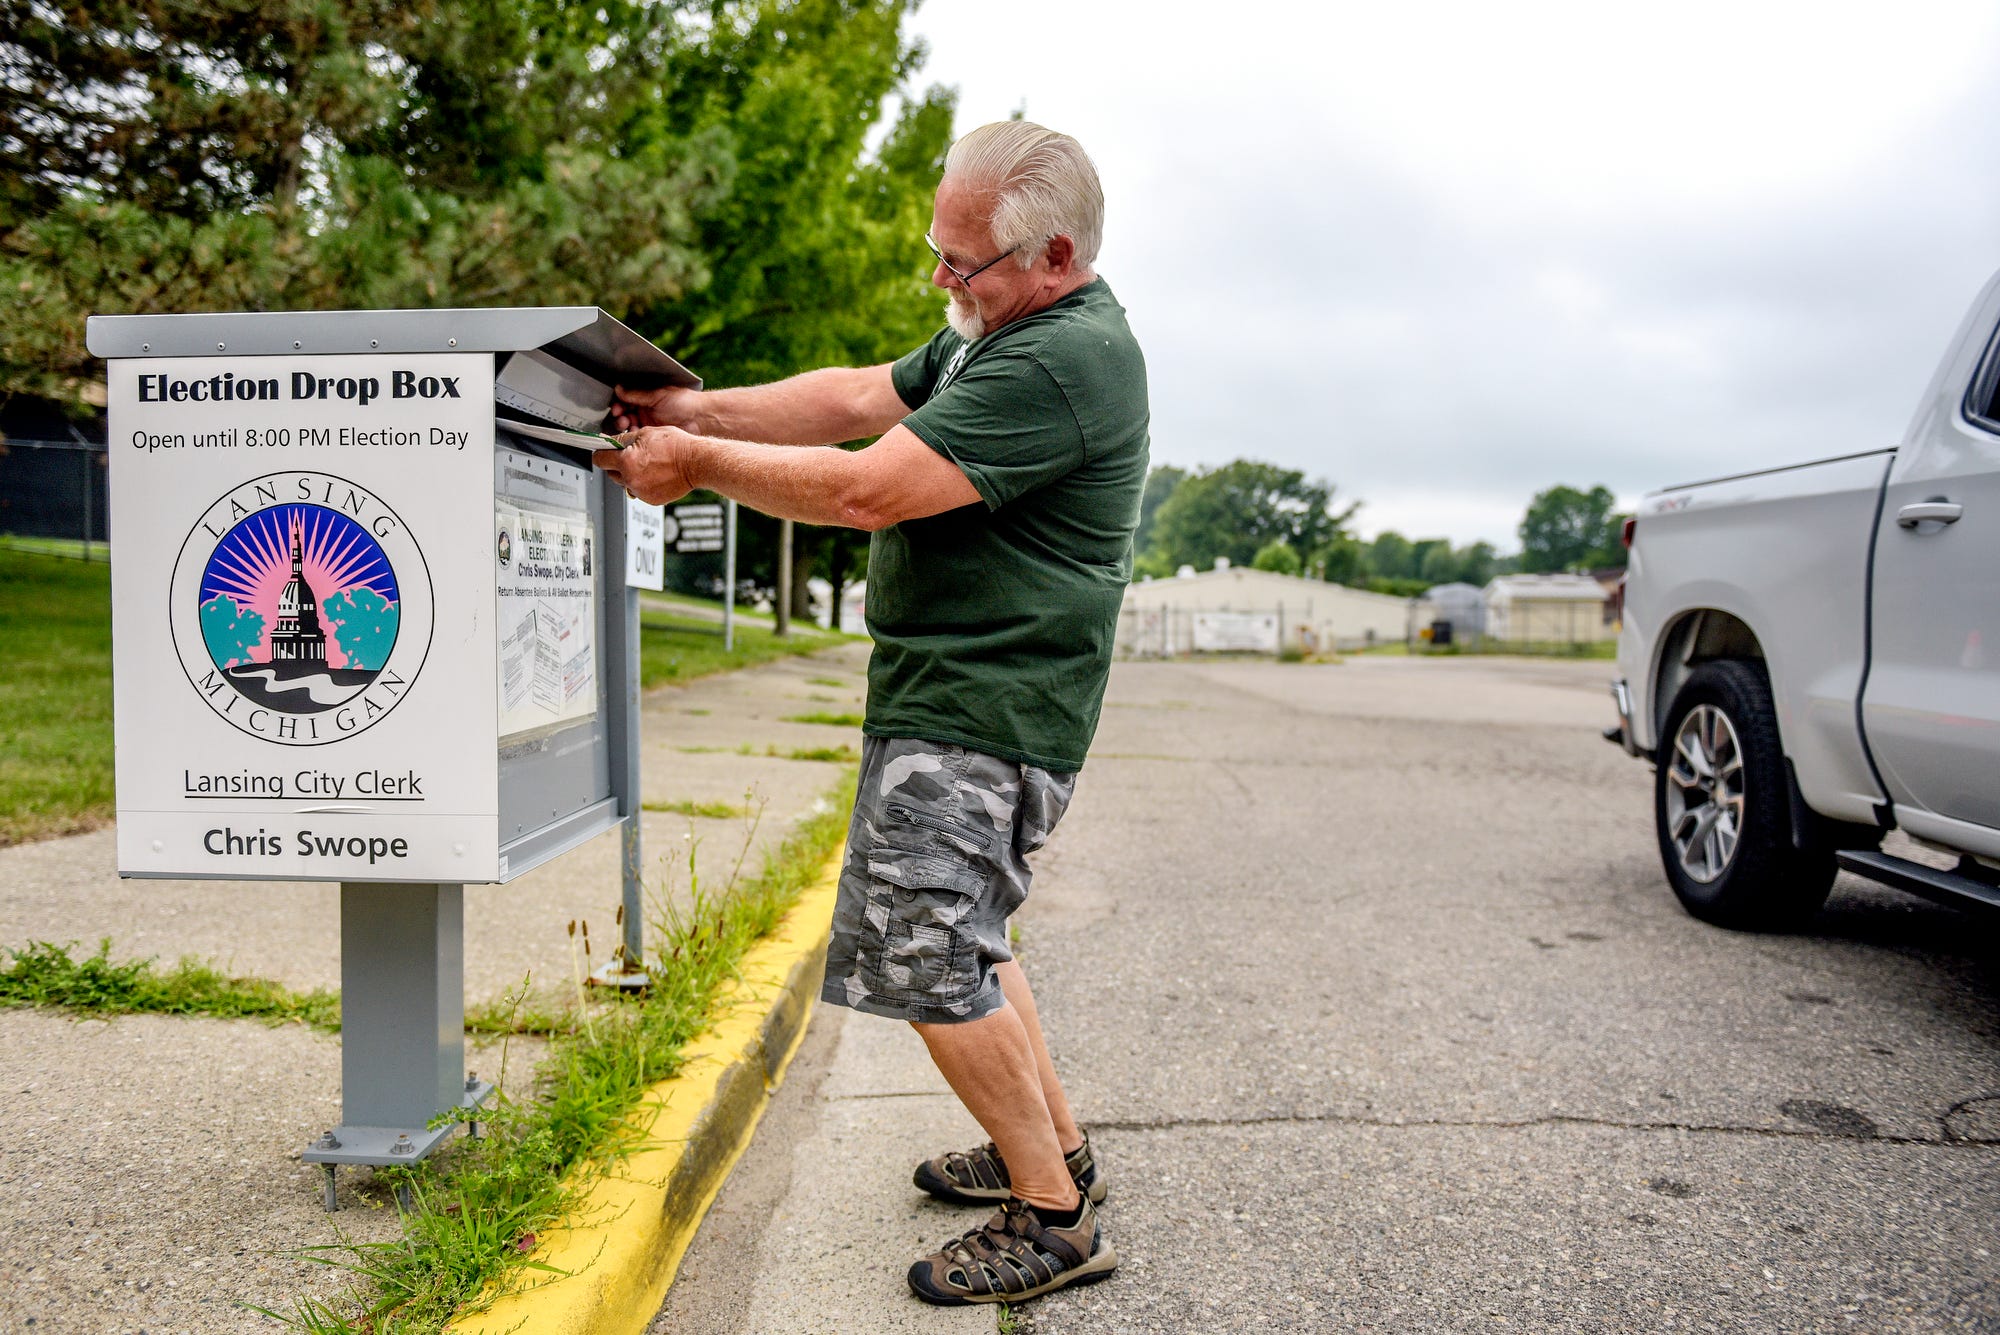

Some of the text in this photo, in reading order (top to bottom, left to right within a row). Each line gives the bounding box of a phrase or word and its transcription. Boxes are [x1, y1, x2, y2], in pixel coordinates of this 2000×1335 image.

[138, 370, 461, 406] Election Drop Box
[132, 426, 469, 454] Open until 8:00 PM Election Day
[203, 477, 396, 540] LANSING
[518, 563, 533, 577] Chris
[554, 566, 565, 581] City
[565, 567, 580, 580] Clerk
[635, 545, 657, 576] ONLY
[497, 586, 514, 597] Return
[198, 669, 406, 742] MICHIGAN
[184, 768, 423, 797] Lansing City Clerk
[203, 827, 409, 865] Chris Swope
